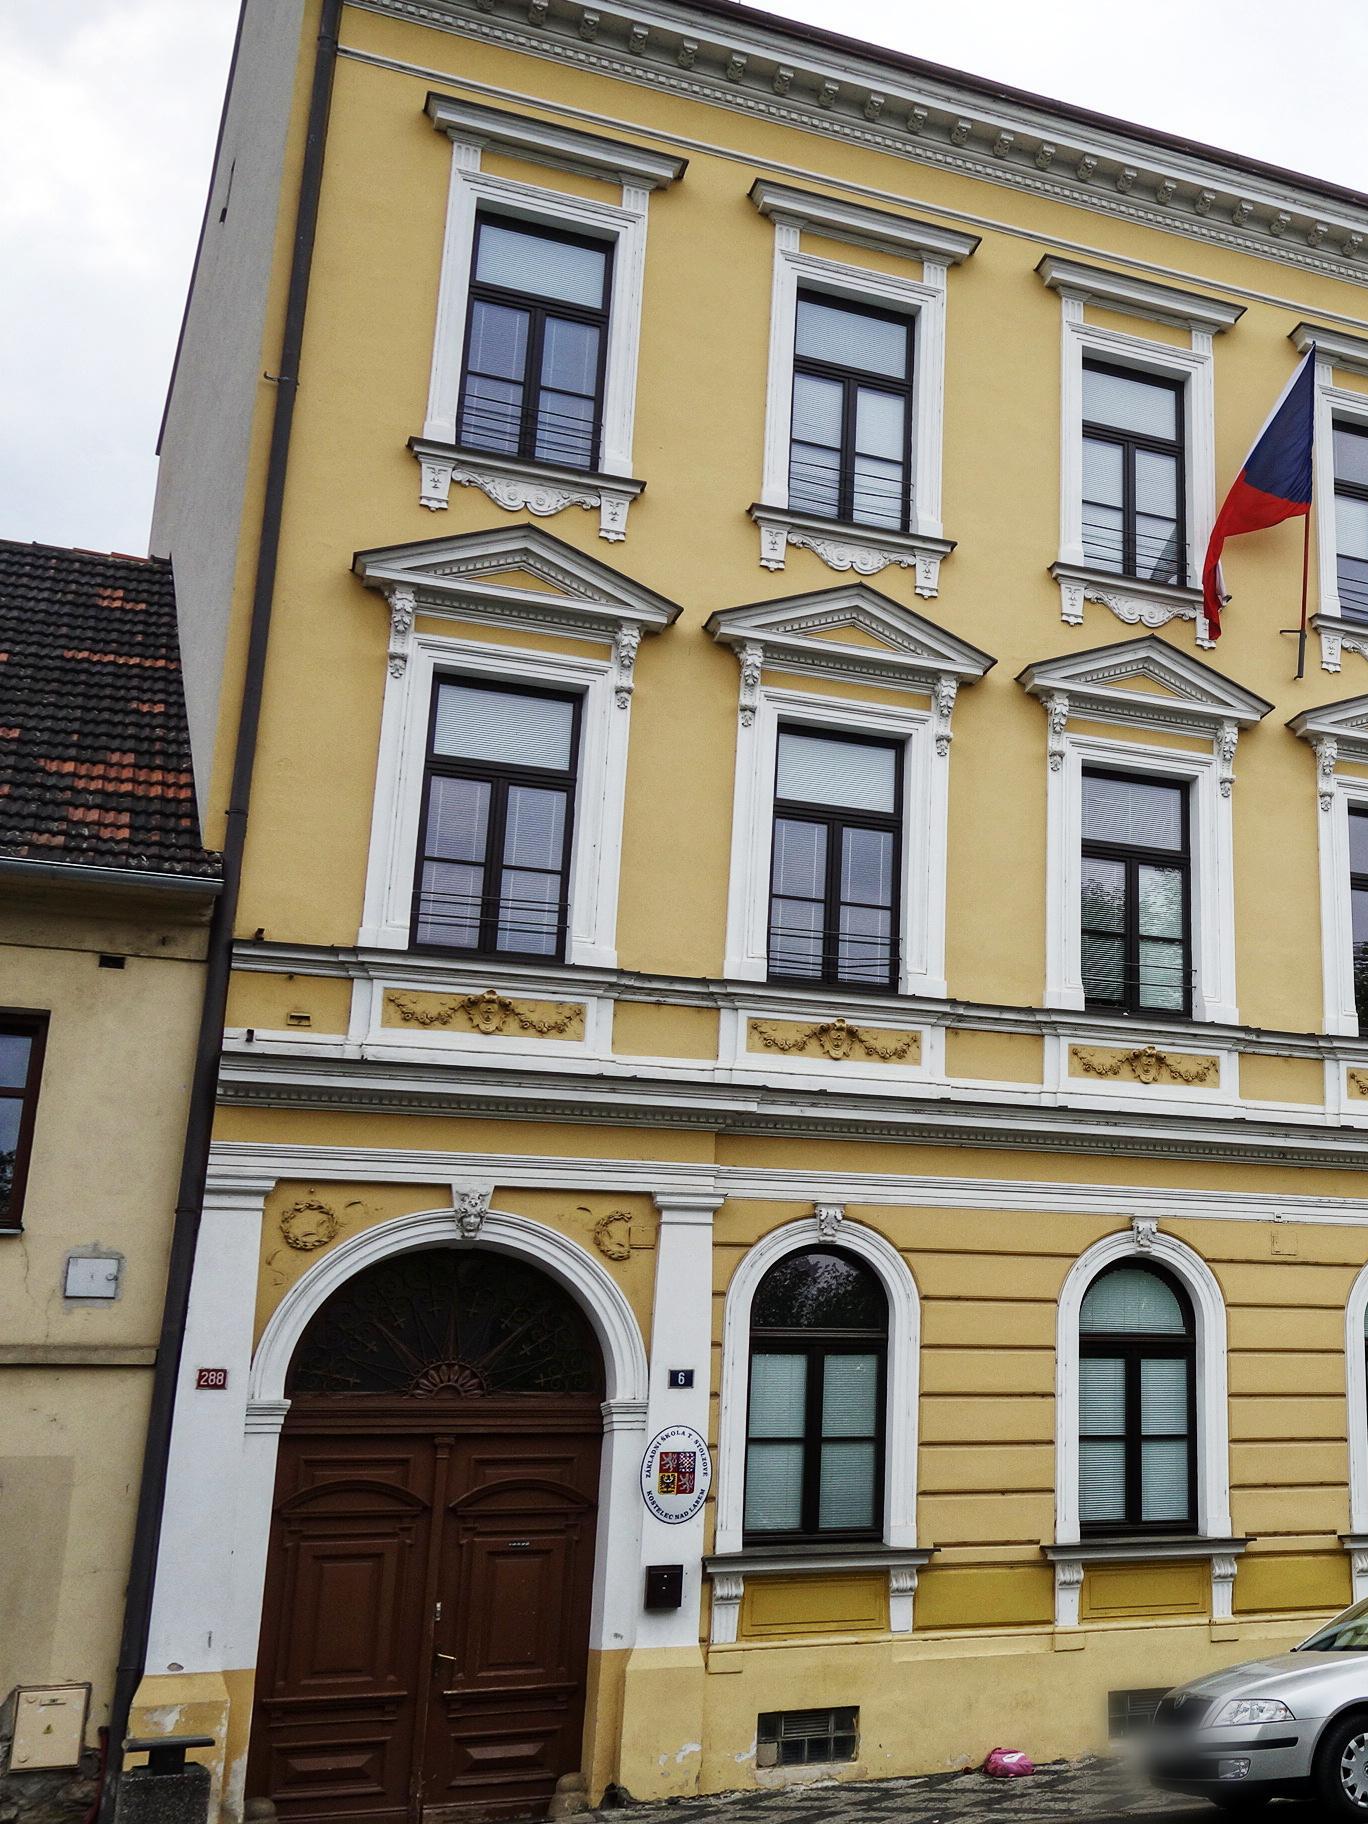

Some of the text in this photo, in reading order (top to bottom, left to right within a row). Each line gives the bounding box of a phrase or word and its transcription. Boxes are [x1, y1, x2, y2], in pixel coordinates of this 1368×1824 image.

[199, 1371, 224, 1385] 288
[678, 1371, 685, 1385] 6
[646, 1488, 705, 1520] KOSTELEC NAD LABEM
